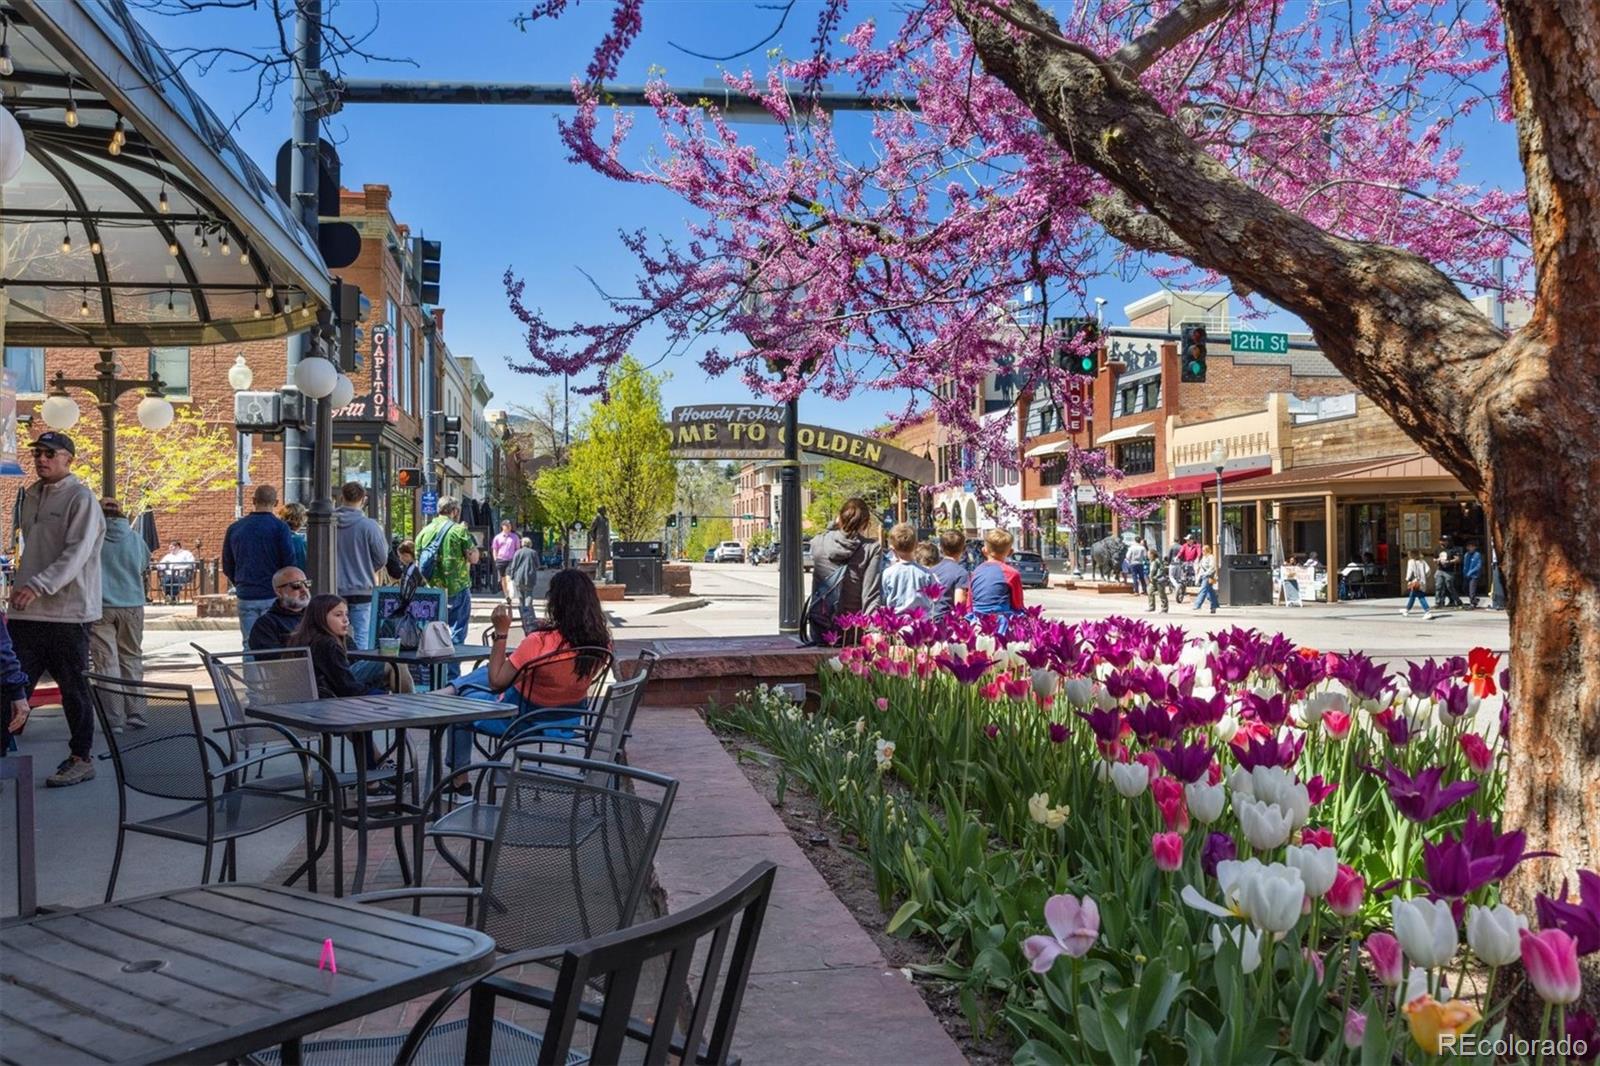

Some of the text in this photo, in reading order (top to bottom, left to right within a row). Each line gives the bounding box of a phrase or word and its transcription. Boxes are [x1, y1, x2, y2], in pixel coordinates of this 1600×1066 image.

[1233, 334, 1286, 351] 12th St
[373, 333, 385, 417] CAPITOL
[679, 406, 786, 424] Howdy Folks!
[728, 422, 766, 441] TO
